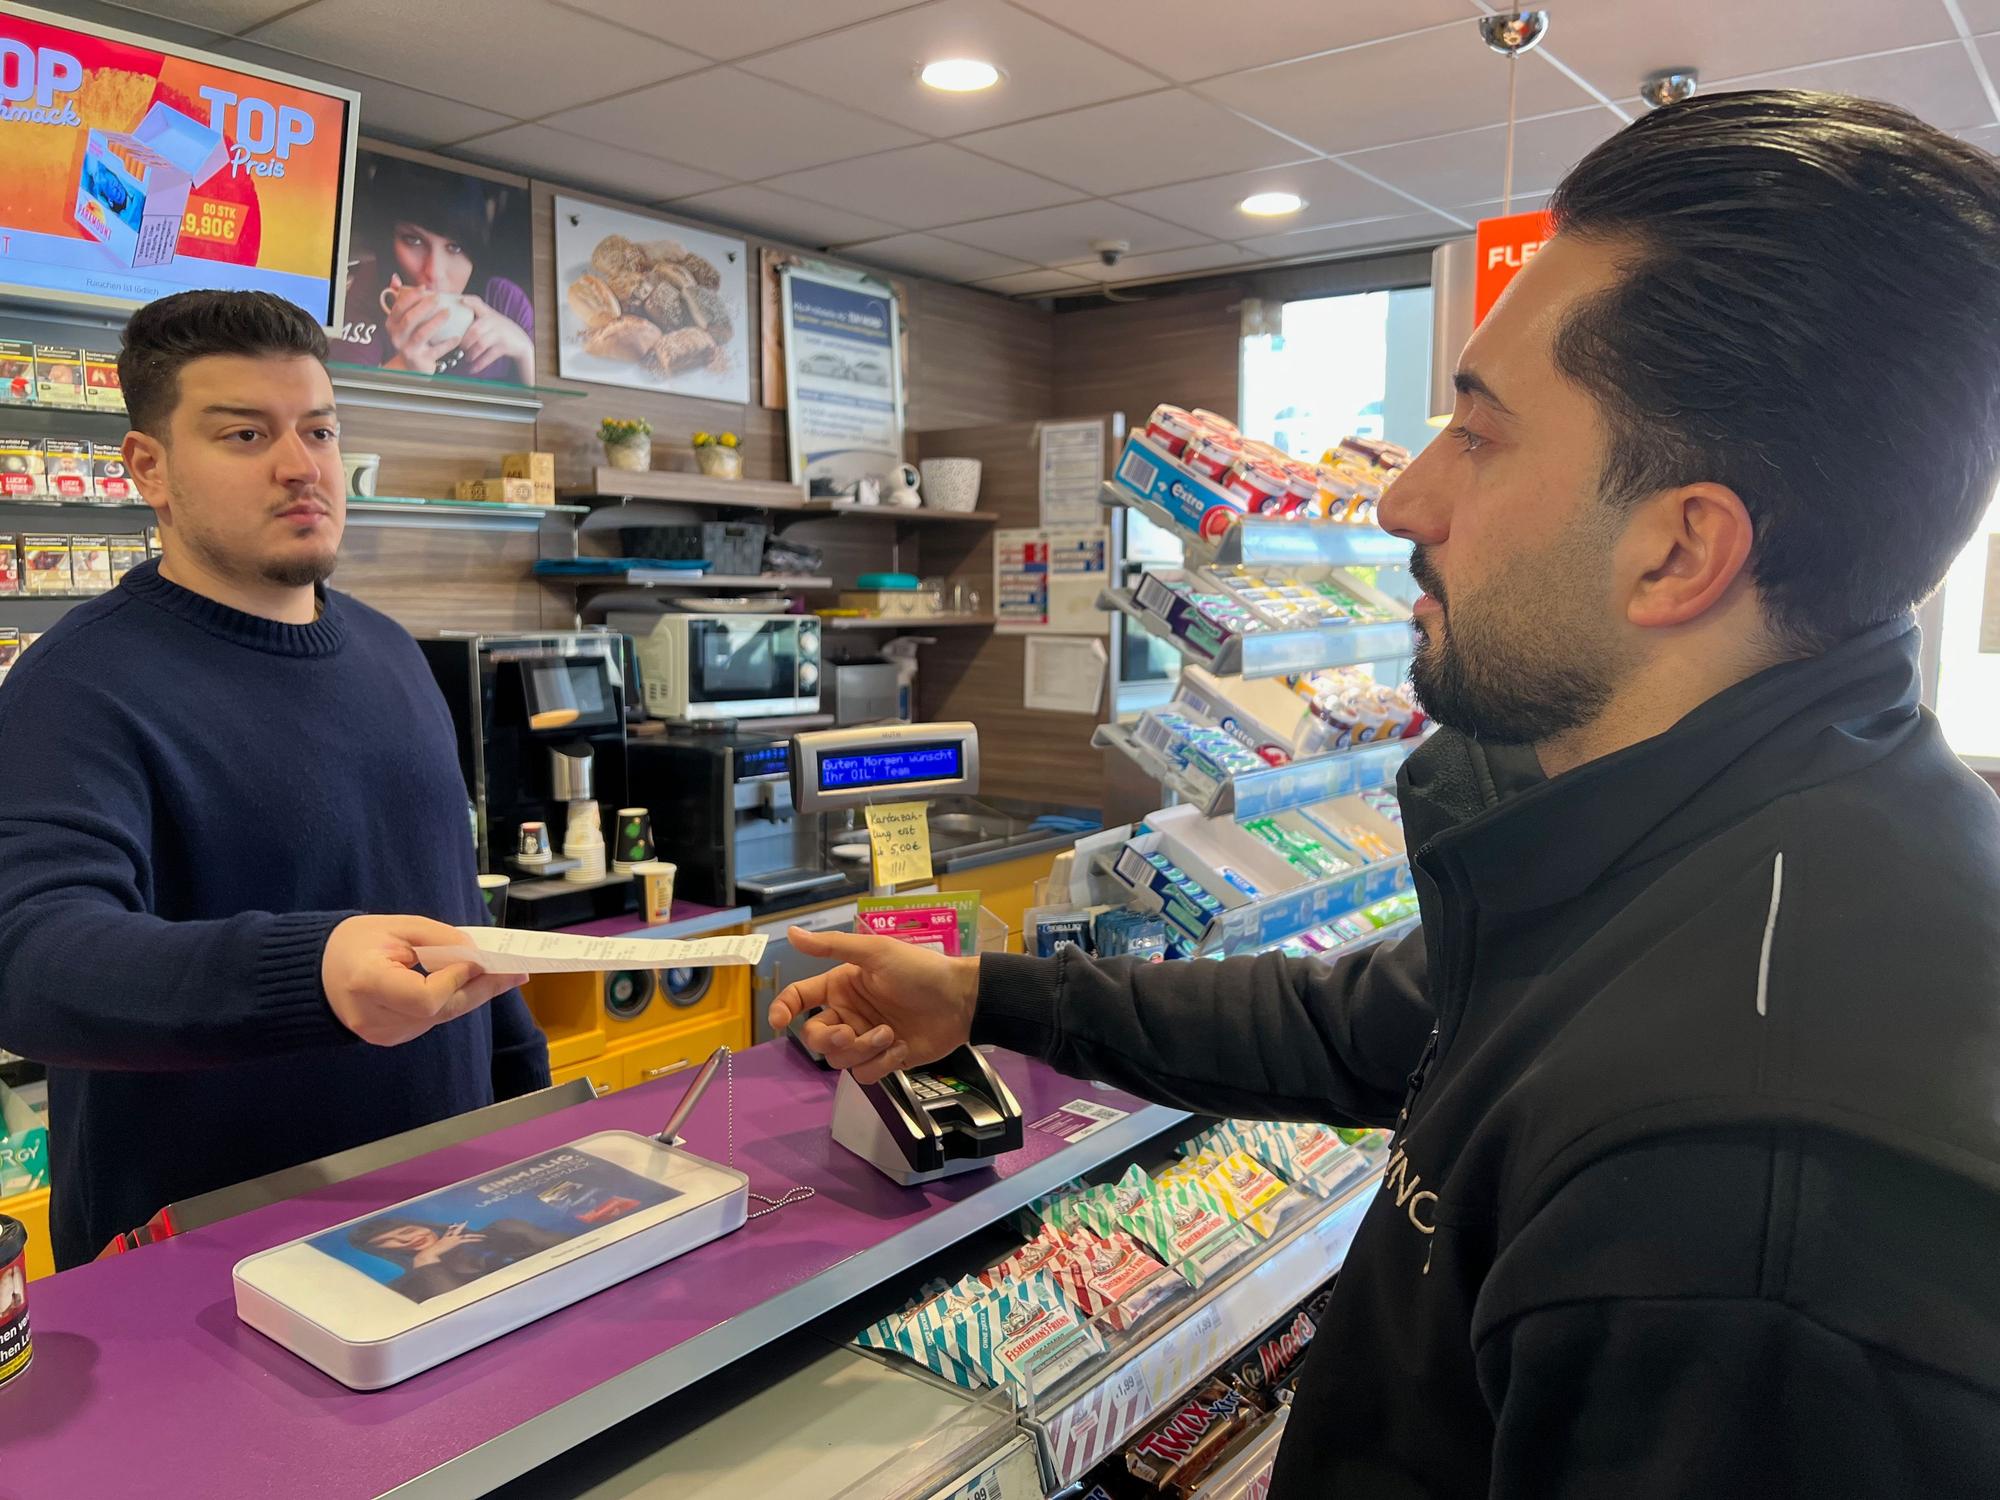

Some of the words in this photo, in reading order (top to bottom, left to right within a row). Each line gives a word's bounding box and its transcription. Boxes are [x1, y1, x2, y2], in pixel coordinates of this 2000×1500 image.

[199, 85, 315, 160] TOP
[229, 144, 286, 179] Preis
[78, 203, 111, 241] PARAMOUNT
[203, 202, 216, 215] 60
[217, 205, 237, 218] STK
[180, 212, 235, 240] 9,90€
[1488, 240, 1548, 271] FLE
[823, 758, 858, 771] Guten
[863, 755, 903, 768] Morgen
[909, 750, 953, 762] wünscht
[825, 771, 845, 783] Ihr
[851, 767, 876, 780] OIL!
[884, 765, 911, 777] Team
[872, 917, 886, 929] 10
[887, 916, 896, 928] €
[1004, 1324, 1050, 1362] FISHERMAN'S
[1257, 1311, 1316, 1385] Mars
[1118, 1376, 1135, 1396] 1,99
[1136, 1401, 1215, 1468] TWIX
